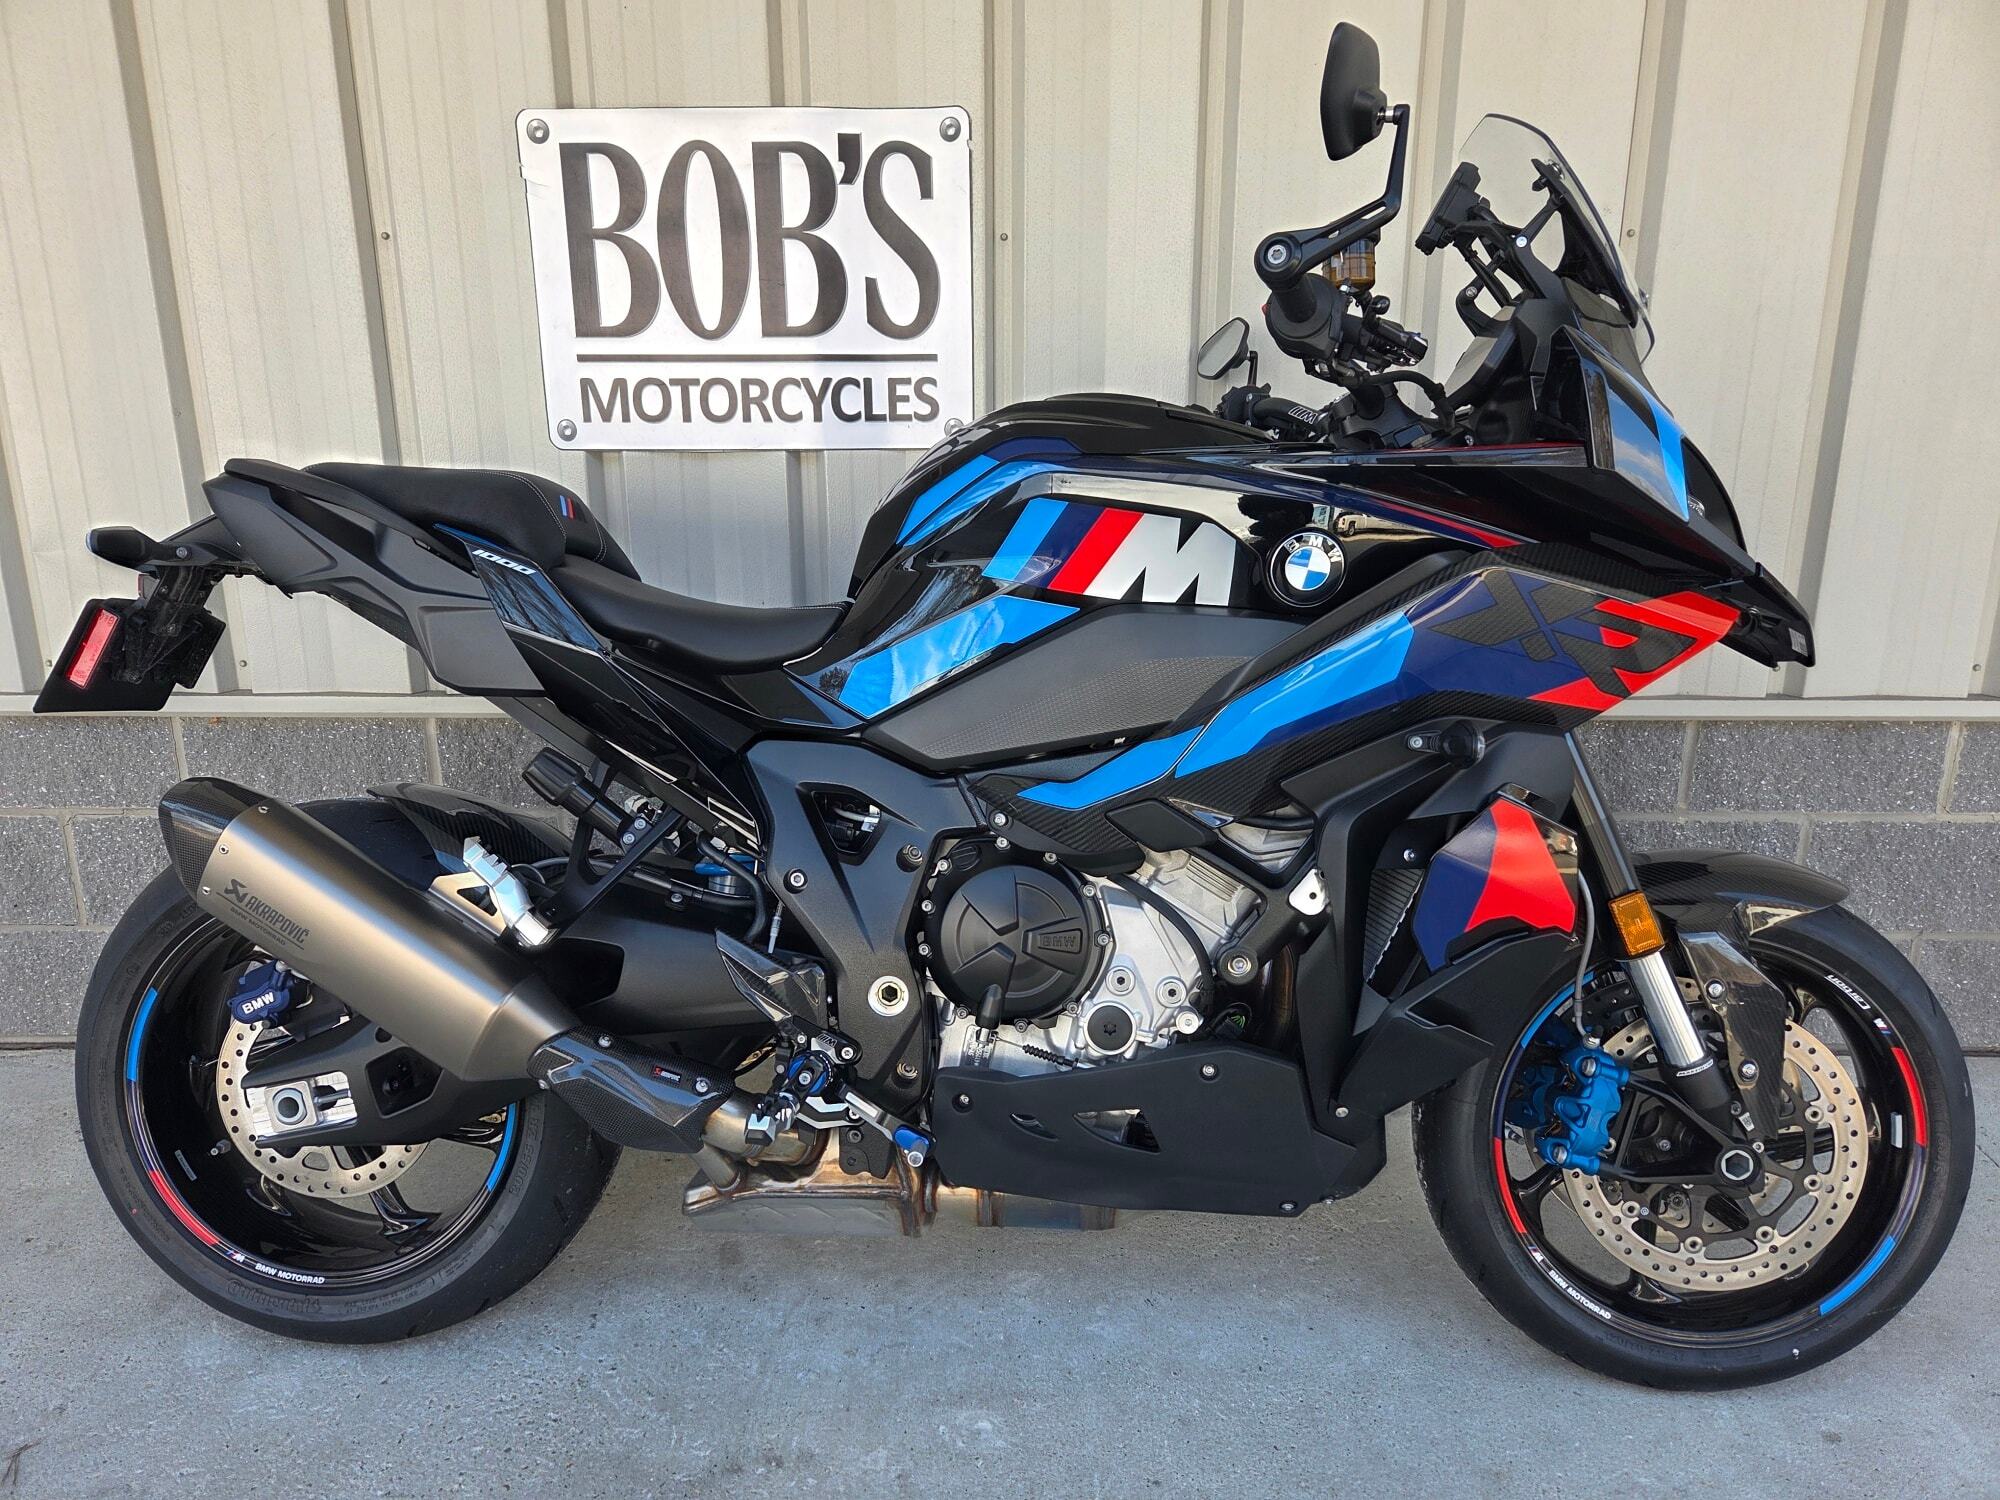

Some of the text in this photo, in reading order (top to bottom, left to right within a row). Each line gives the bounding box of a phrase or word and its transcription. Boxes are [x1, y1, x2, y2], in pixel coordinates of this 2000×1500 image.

[559, 132, 941, 340] BOB'S
[579, 377, 940, 424] MOTORCYCLES
[472, 549, 537, 575] 1000
[1083, 512, 1238, 607] M
[1284, 535, 1342, 563] BMW
[241, 991, 275, 1015] BMW
[255, 1262, 277, 1276] BMW
[277, 1270, 326, 1284] MOTORRAD
[1548, 1269, 1568, 1290] BMW
[1566, 1286, 1612, 1320] MOTORRAD
